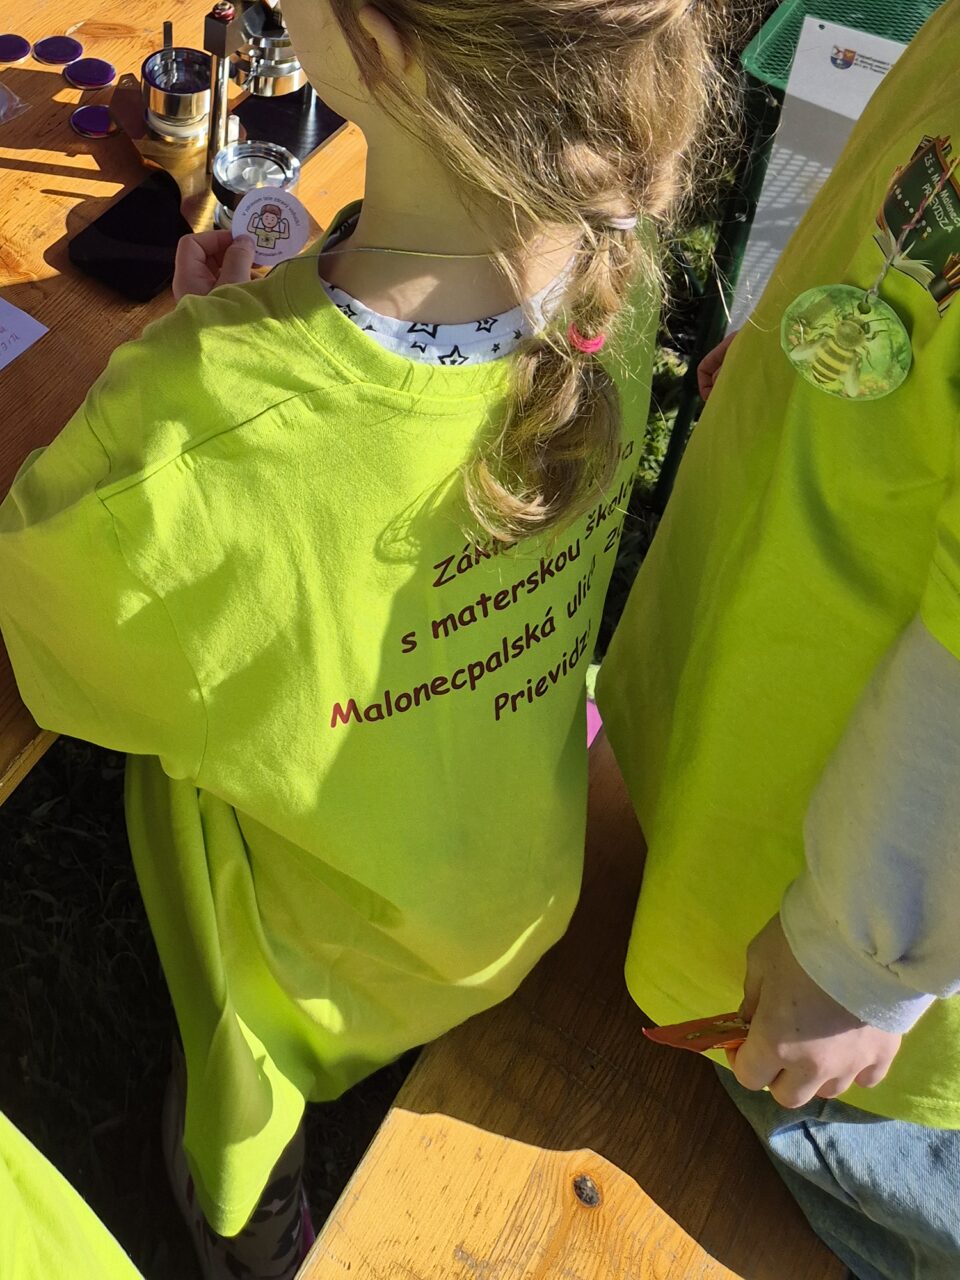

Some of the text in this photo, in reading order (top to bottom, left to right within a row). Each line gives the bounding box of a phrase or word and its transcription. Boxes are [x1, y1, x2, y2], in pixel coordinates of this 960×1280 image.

[922, 182, 954, 233] PREVIDZA
[400, 630, 418, 654] s
[431, 538, 580, 640] materskou
[330, 606, 556, 728] Malonecpalská
[493, 618, 592, 721] Prievidz
